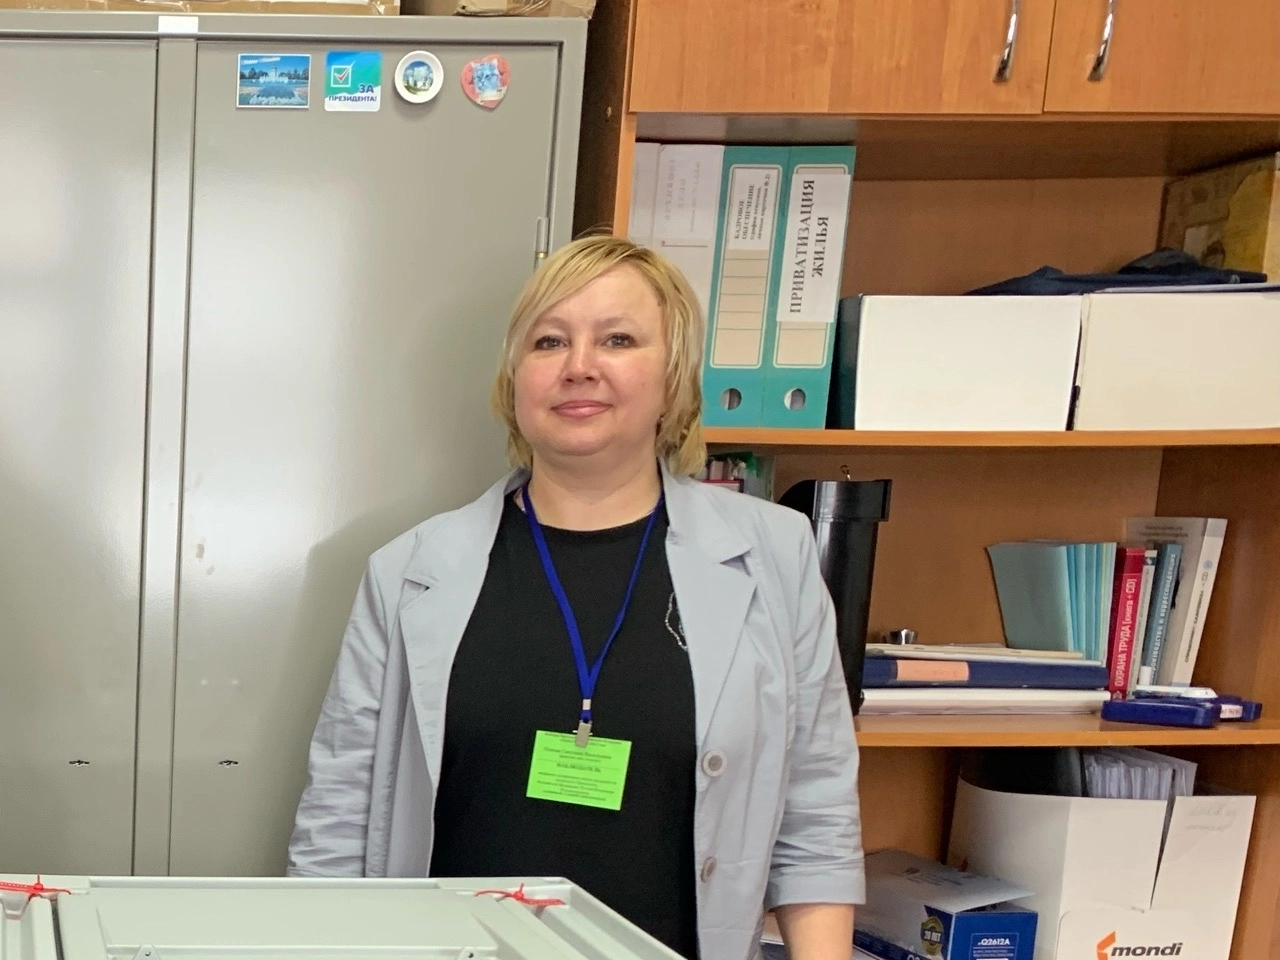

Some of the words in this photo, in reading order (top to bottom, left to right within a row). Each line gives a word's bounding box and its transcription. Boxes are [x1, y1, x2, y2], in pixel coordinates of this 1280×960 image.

[328, 95, 378, 103] ПРЕЗИДЕНТА!
[358, 84, 374, 94] ЗА
[734, 199, 745, 239] КАДРОВОЕ
[742, 184, 755, 240] ОБЕСПЕЧЕНИЕ
[789, 180, 815, 313] ПРИВАТИЗАЦИЯ
[811, 216, 829, 278] ЖИЛЬЯ
[1118, 624, 1131, 652] ТРУДА
[1114, 653, 1128, 687] ОХРАНА
[924, 930, 932, 940] 20
[1111, 942, 1183, 957] mondi
